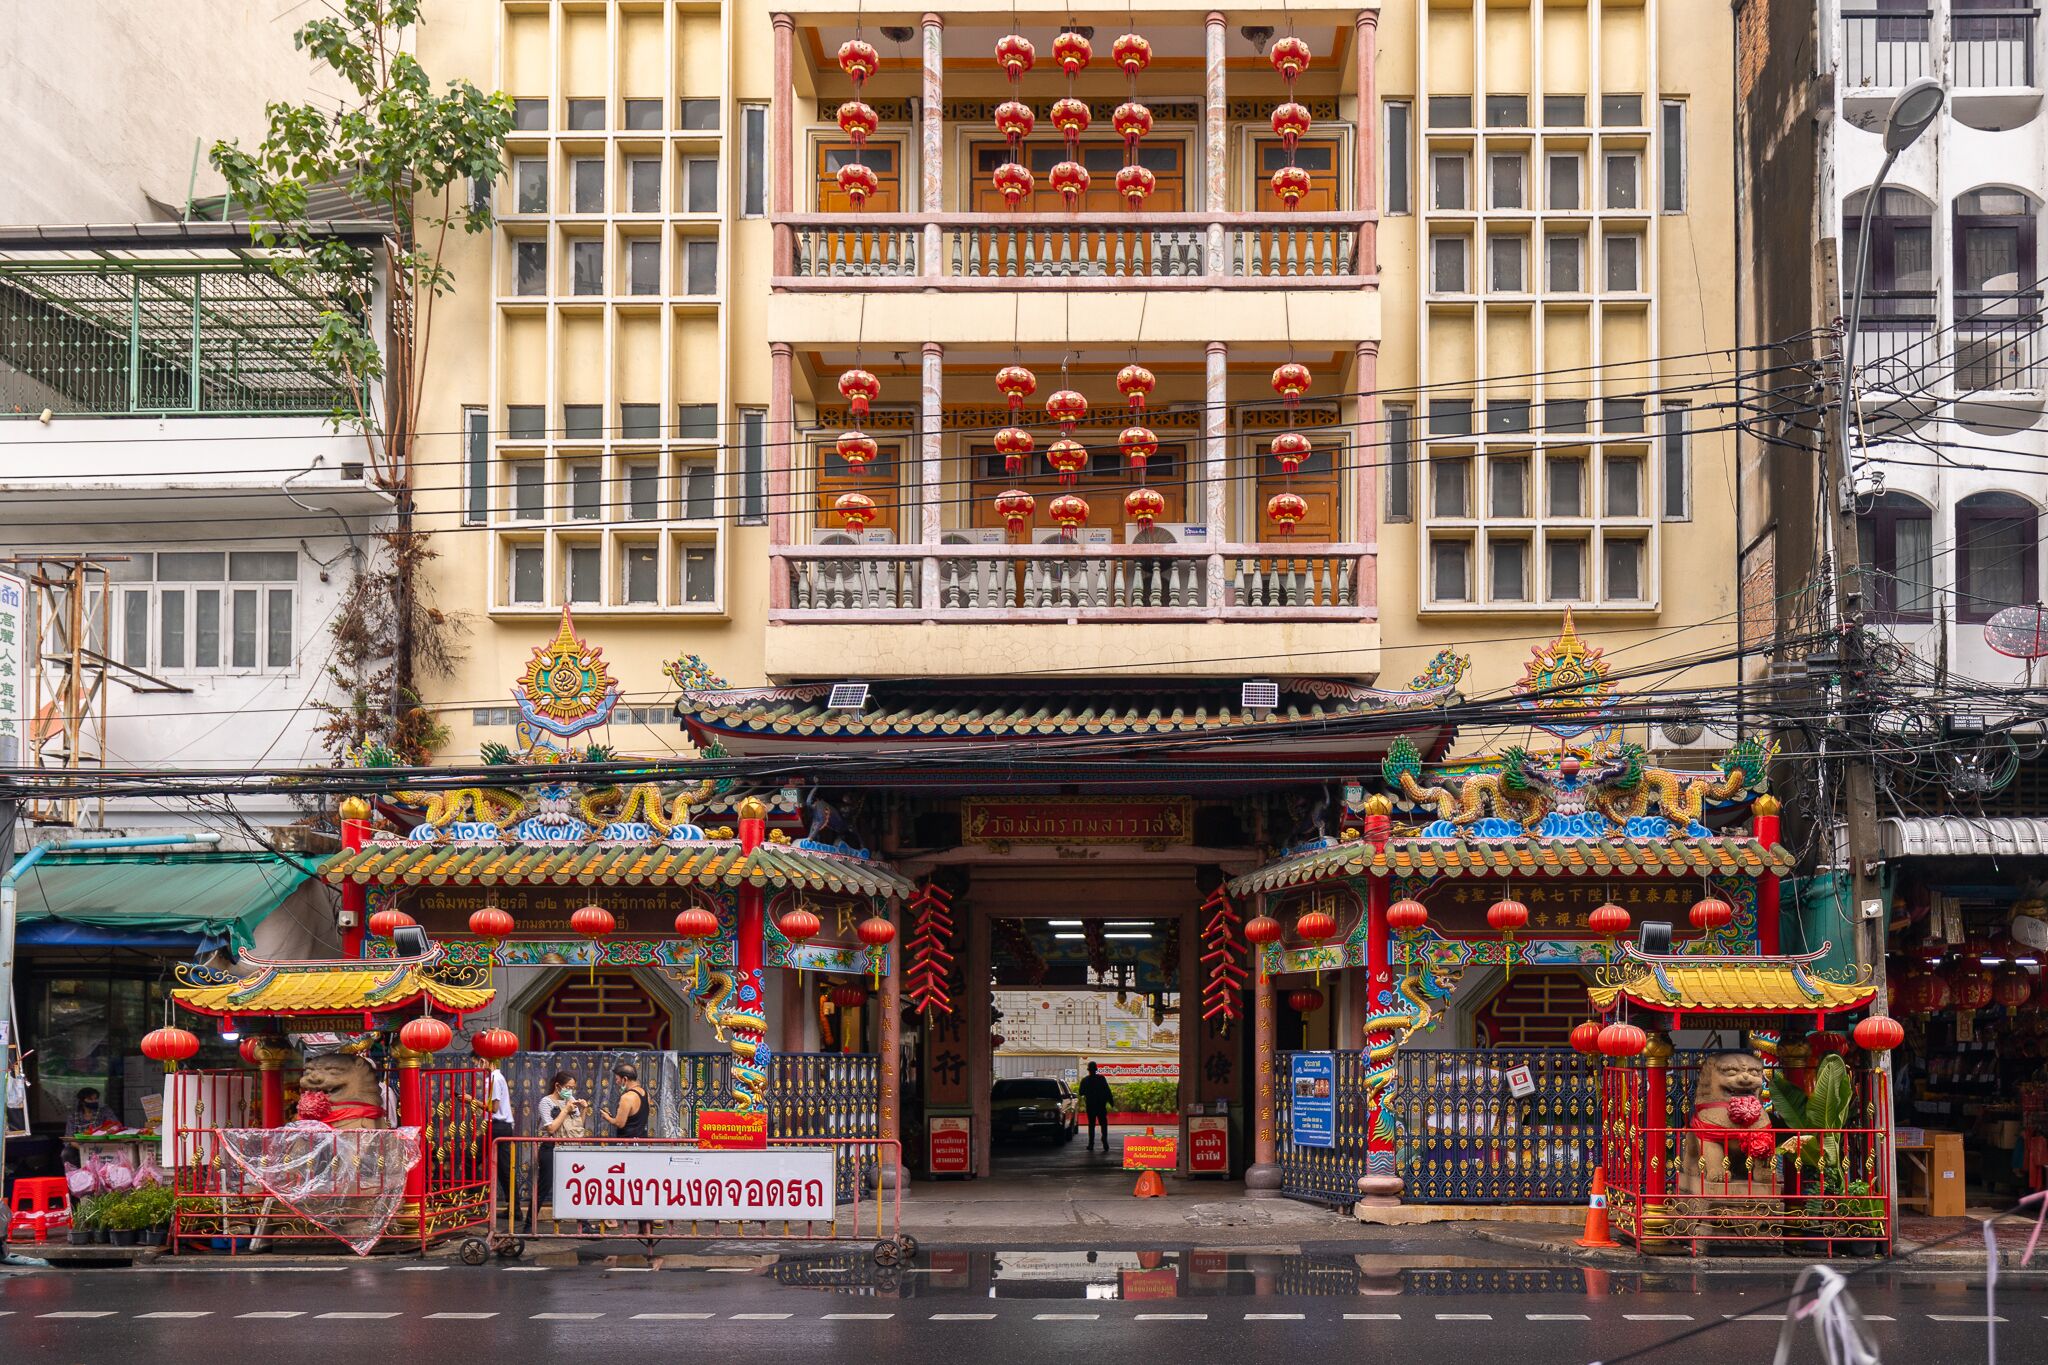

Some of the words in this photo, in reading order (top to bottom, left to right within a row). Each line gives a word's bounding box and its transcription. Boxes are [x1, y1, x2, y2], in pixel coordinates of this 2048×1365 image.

[0, 611, 16, 736] 高麗人參鹿茸魚
[991, 812, 1164, 833] วัดมังกรกมลาวาส
[701, 1122, 763, 1134] งดจอดรถทุกชนิด
[565, 1162, 824, 1207] วัดมีงานงดจอดรถ
